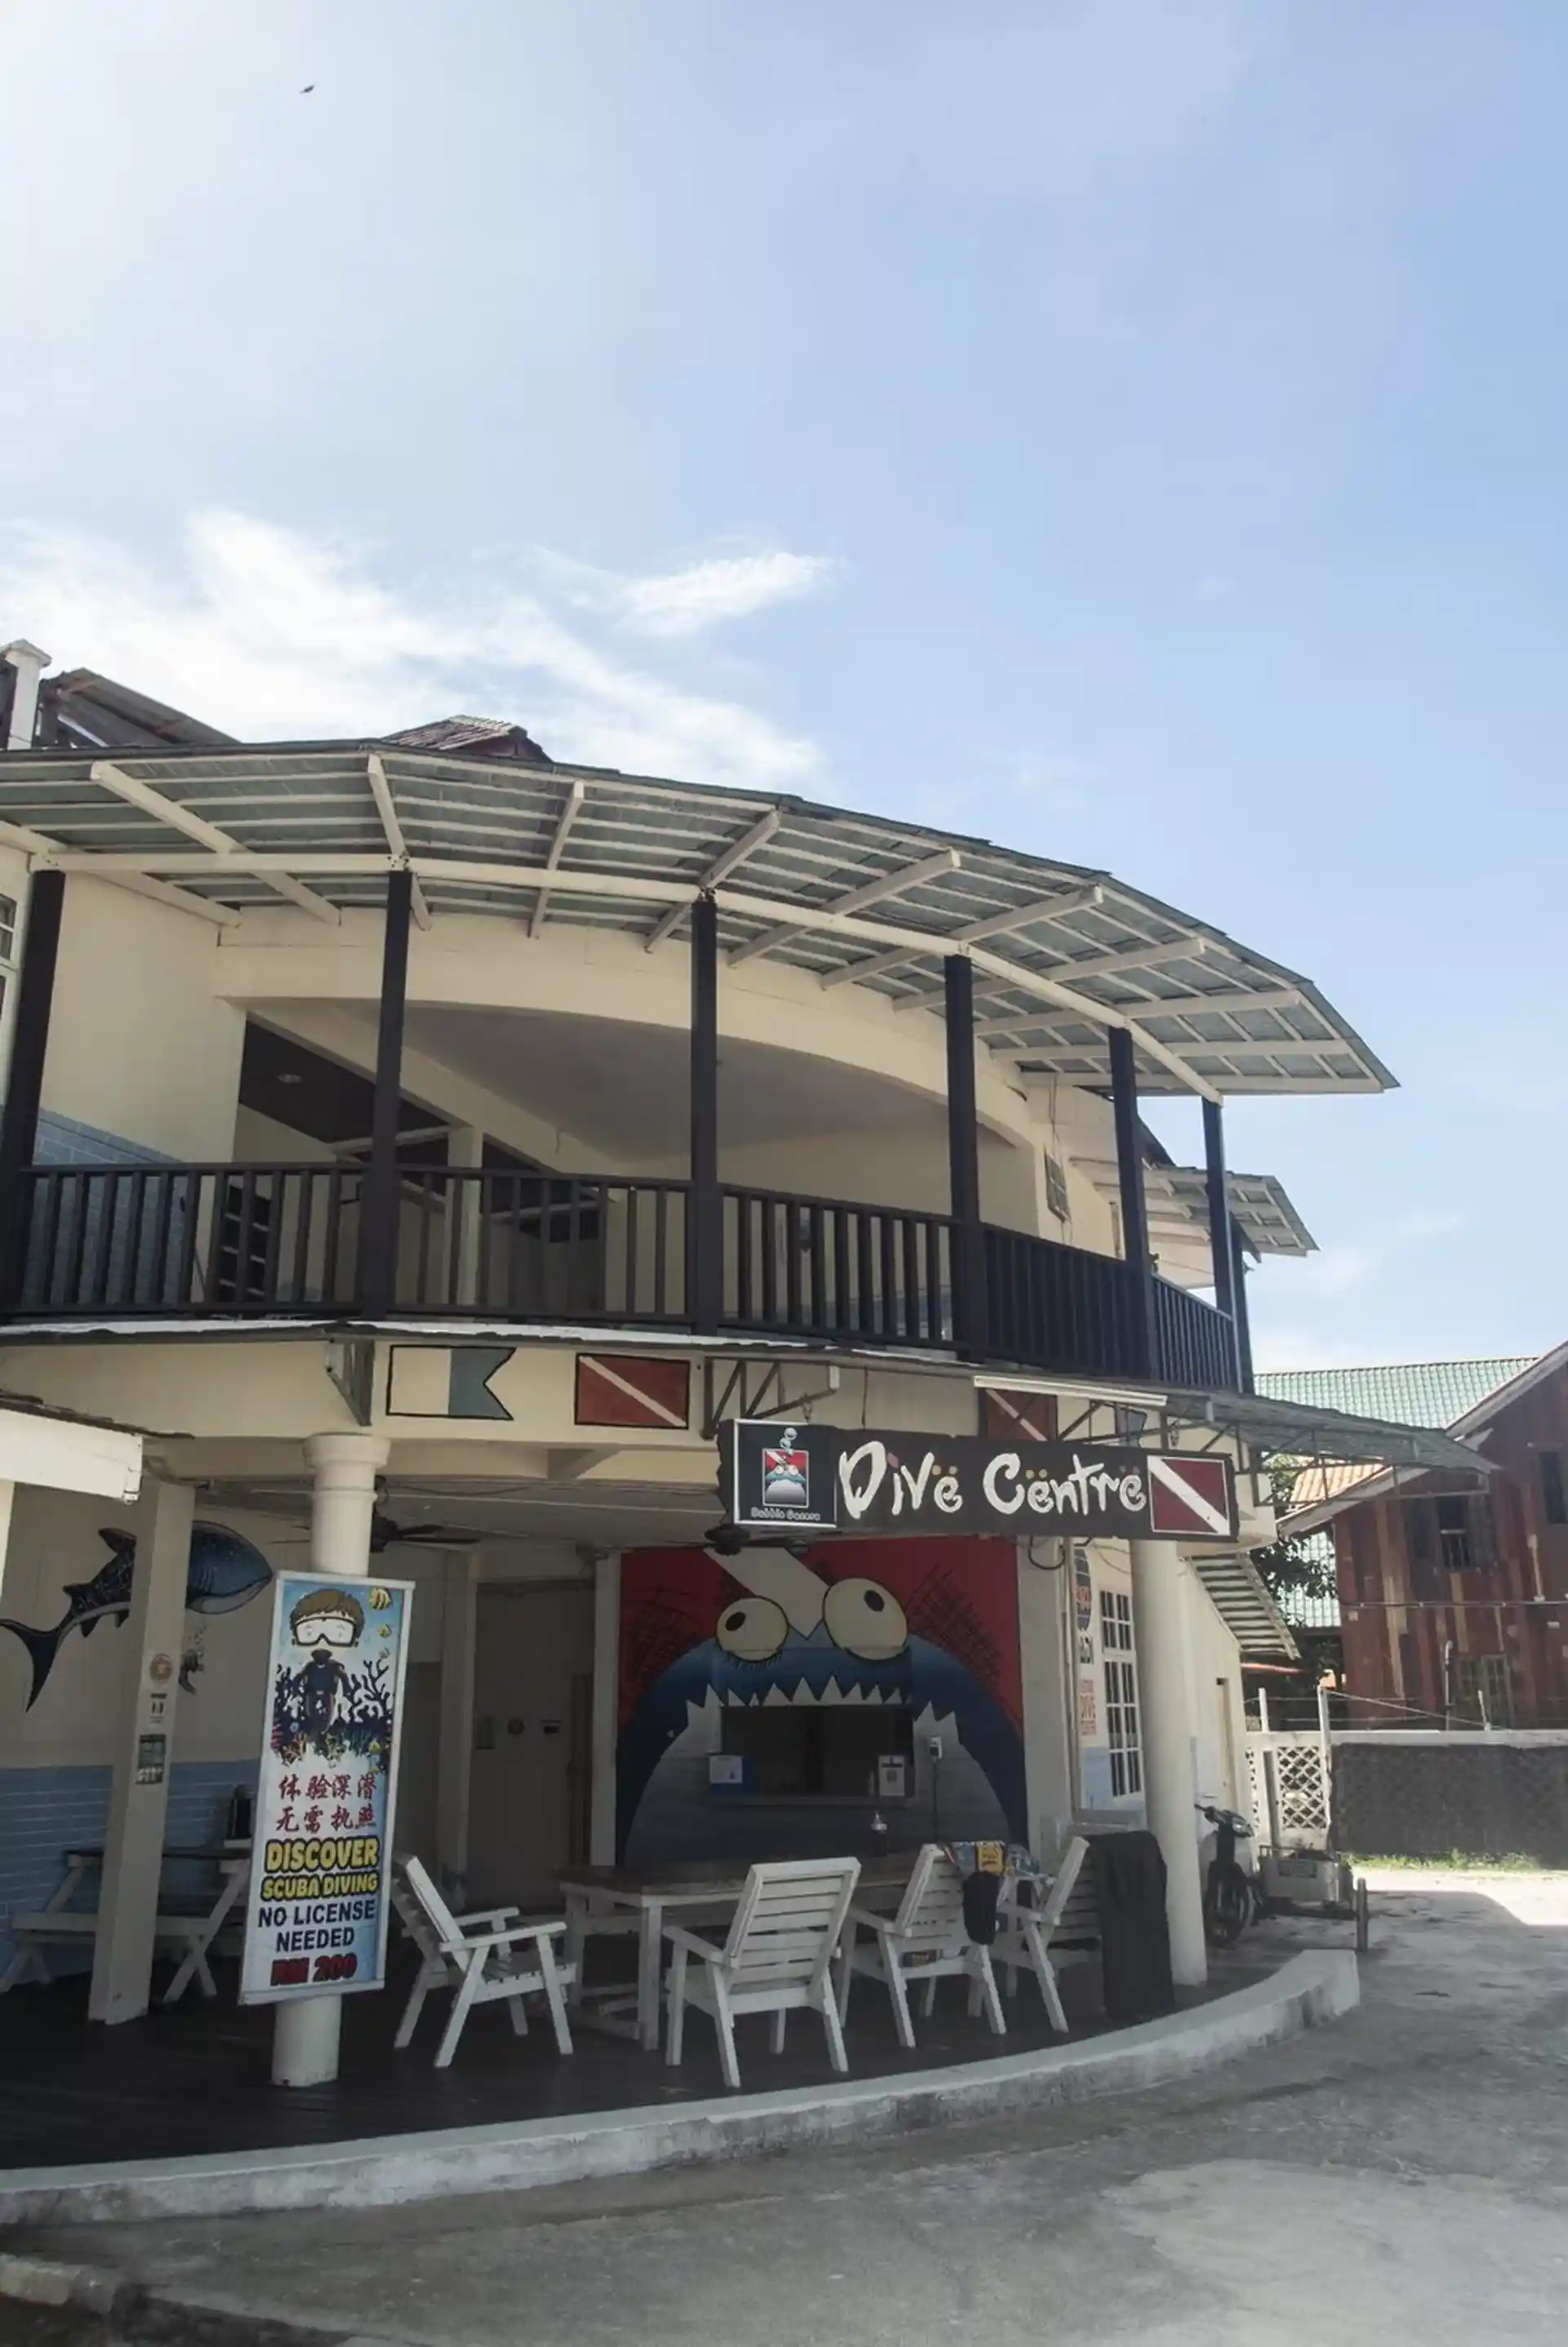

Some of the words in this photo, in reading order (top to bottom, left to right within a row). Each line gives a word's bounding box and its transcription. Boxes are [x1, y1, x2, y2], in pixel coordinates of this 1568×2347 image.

[265, 1836, 380, 1873] DISCOVER
[261, 1874, 320, 1902] SCUBA
[321, 1870, 381, 1899] DIVING
[258, 1906, 287, 1928] NO
[293, 1899, 376, 1926] LICENSE
[276, 1926, 354, 1953] NEEDED
